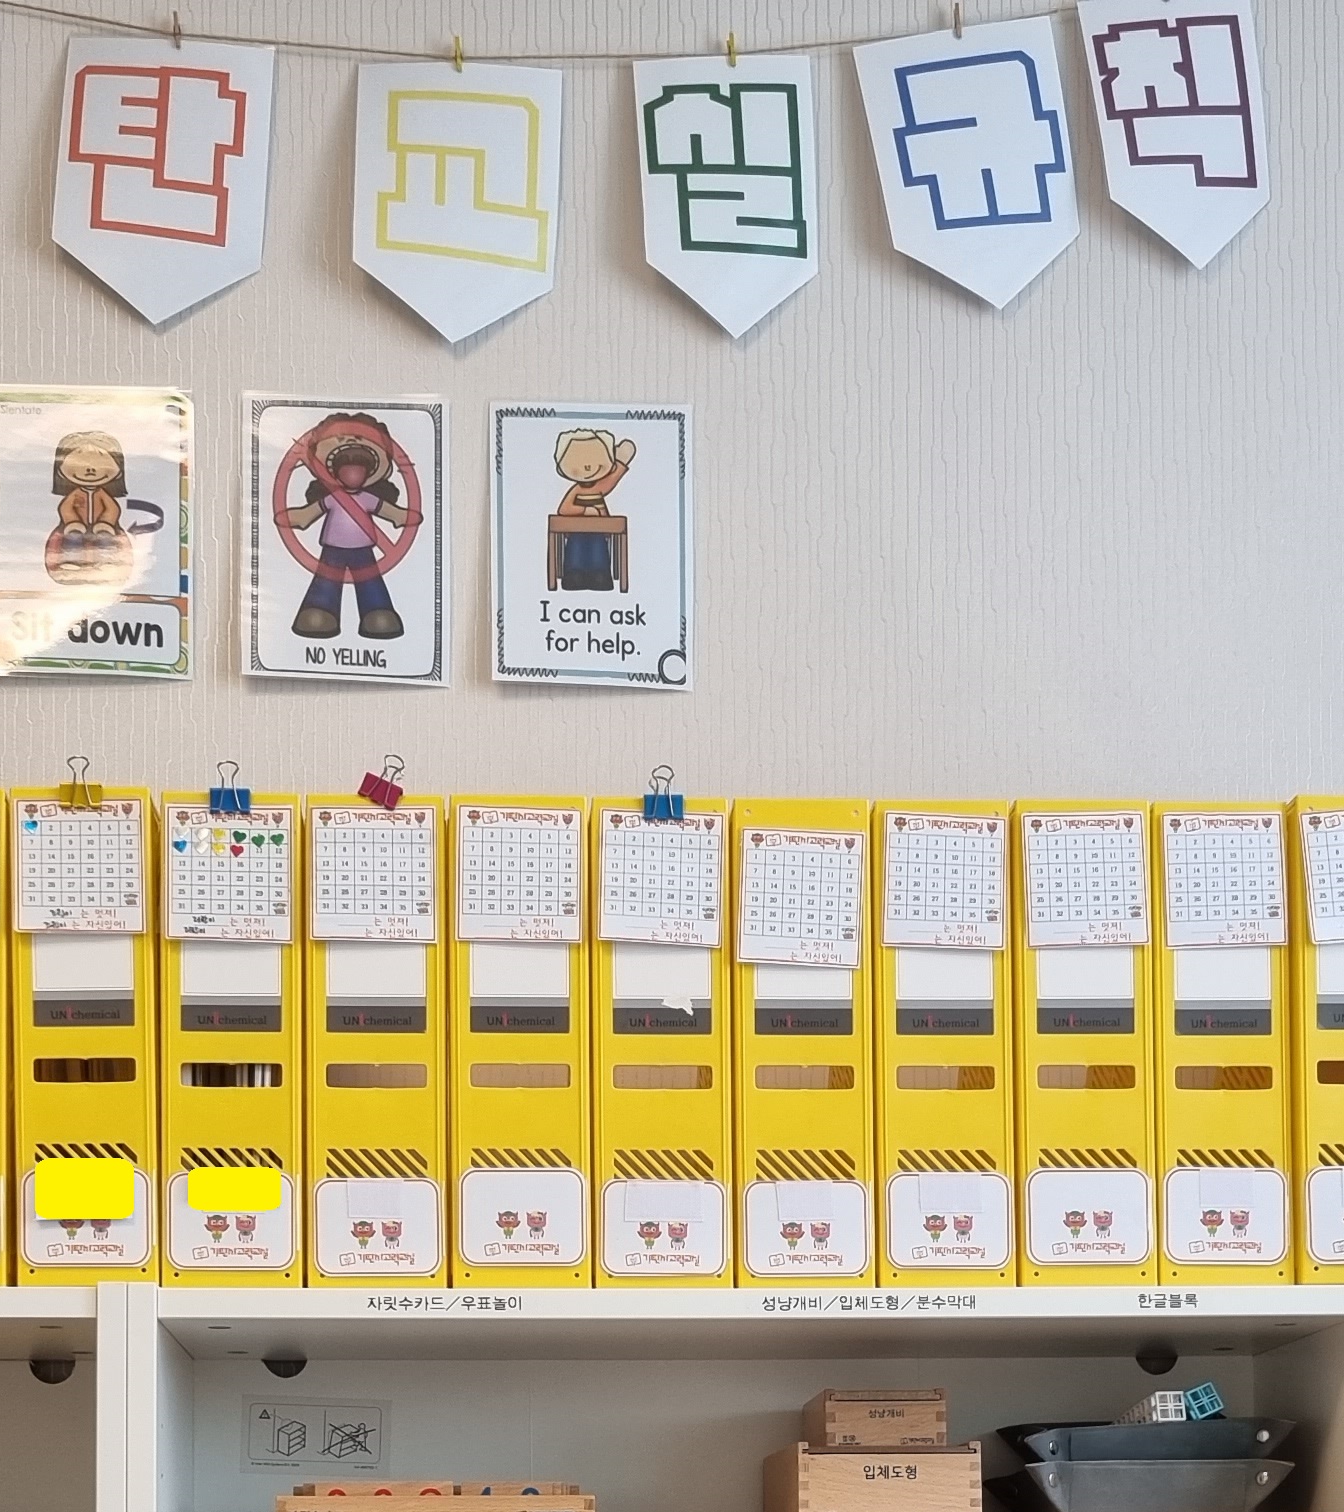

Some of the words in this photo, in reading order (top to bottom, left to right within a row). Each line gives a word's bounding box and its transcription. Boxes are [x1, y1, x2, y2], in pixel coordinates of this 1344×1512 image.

[539, 600, 551, 623] I
[557, 606, 602, 625] can
[609, 603, 646, 627] ask
[68, 618, 163, 648] down
[544, 630, 580, 653] for
[586, 633, 642, 659] help.
[305, 648, 328, 667] NO
[332, 648, 387, 669] YELLING
[1137, 1292, 1199, 1309] 한글블록
[868, 1409, 905, 1419] 성냥개비
[863, 1465, 918, 1480] 입체도형
